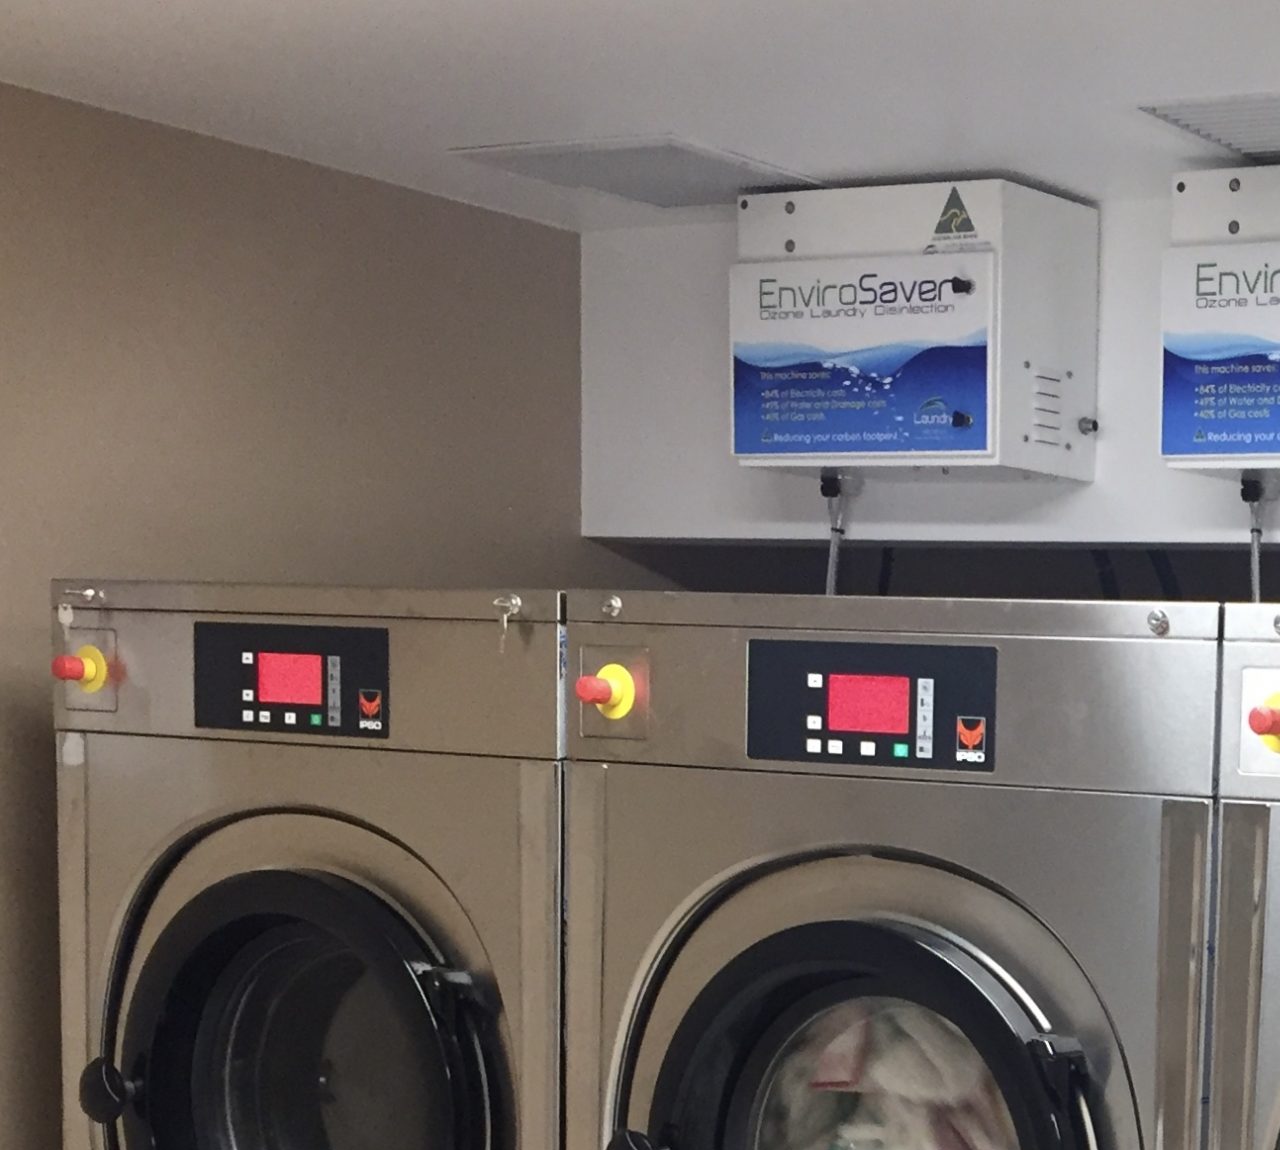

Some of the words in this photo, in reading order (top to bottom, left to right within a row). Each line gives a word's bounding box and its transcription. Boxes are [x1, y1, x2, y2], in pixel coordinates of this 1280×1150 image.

[760, 274, 954, 309] EnviroSaver
[1196, 297, 1248, 309] Ozone
[760, 309, 804, 320] Ozone
[810, 307, 867, 319] Laundry
[874, 303, 955, 316] Disinfection
[1211, 364, 1249, 374] machine
[1256, 396, 1275, 405] and
[1228, 408, 1246, 419] Gas
[1207, 431, 1251, 443] Reducing
[1253, 431, 1275, 442] your
